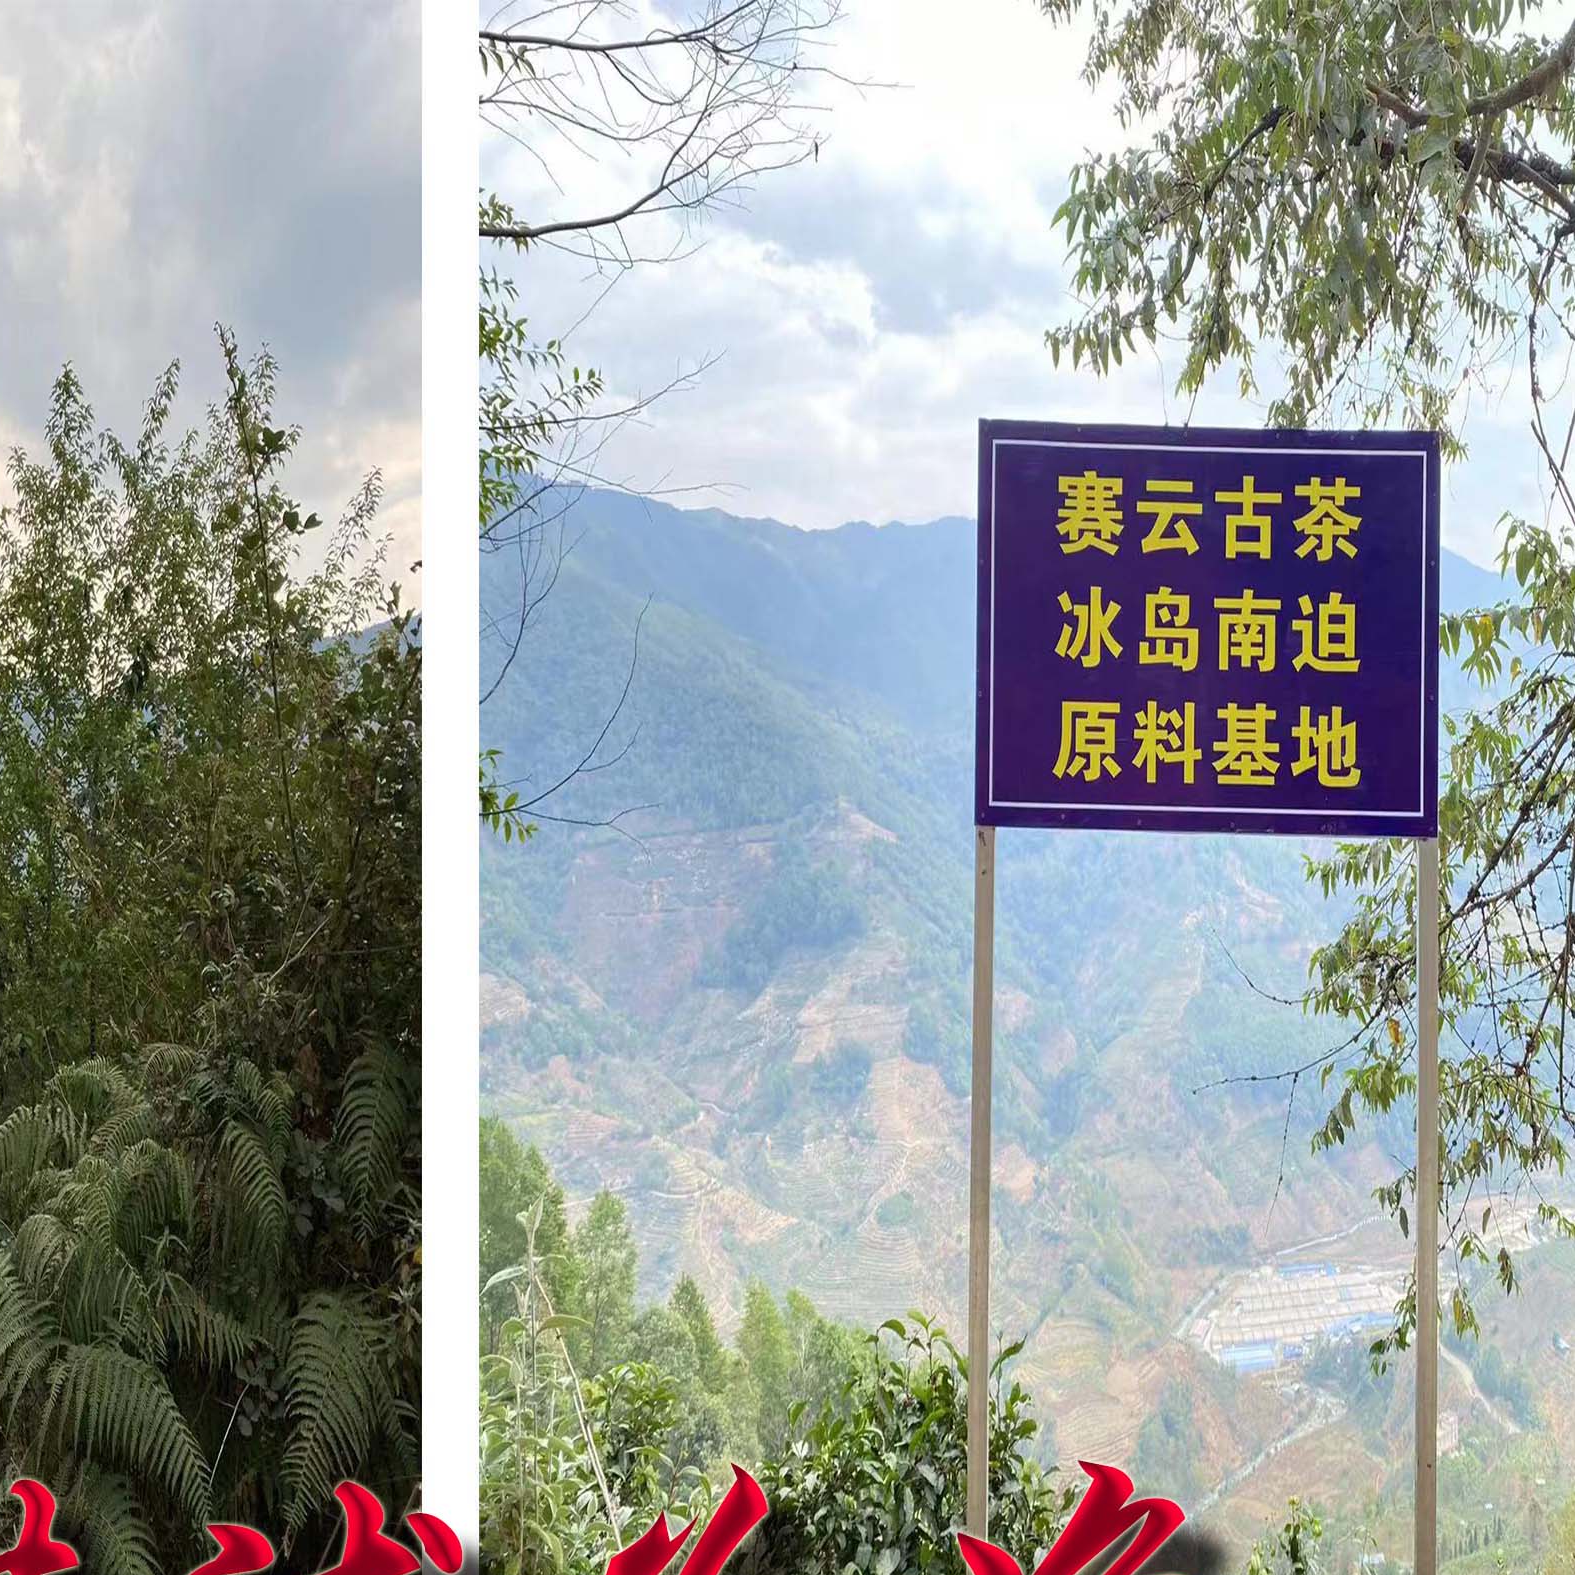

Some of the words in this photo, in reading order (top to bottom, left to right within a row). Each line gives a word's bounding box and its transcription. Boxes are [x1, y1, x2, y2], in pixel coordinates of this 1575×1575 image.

[1055, 471, 1362, 561] 赛云古茶
[1054, 586, 1361, 672] 冰岛南迫
[1052, 701, 1361, 788] 原料基地
